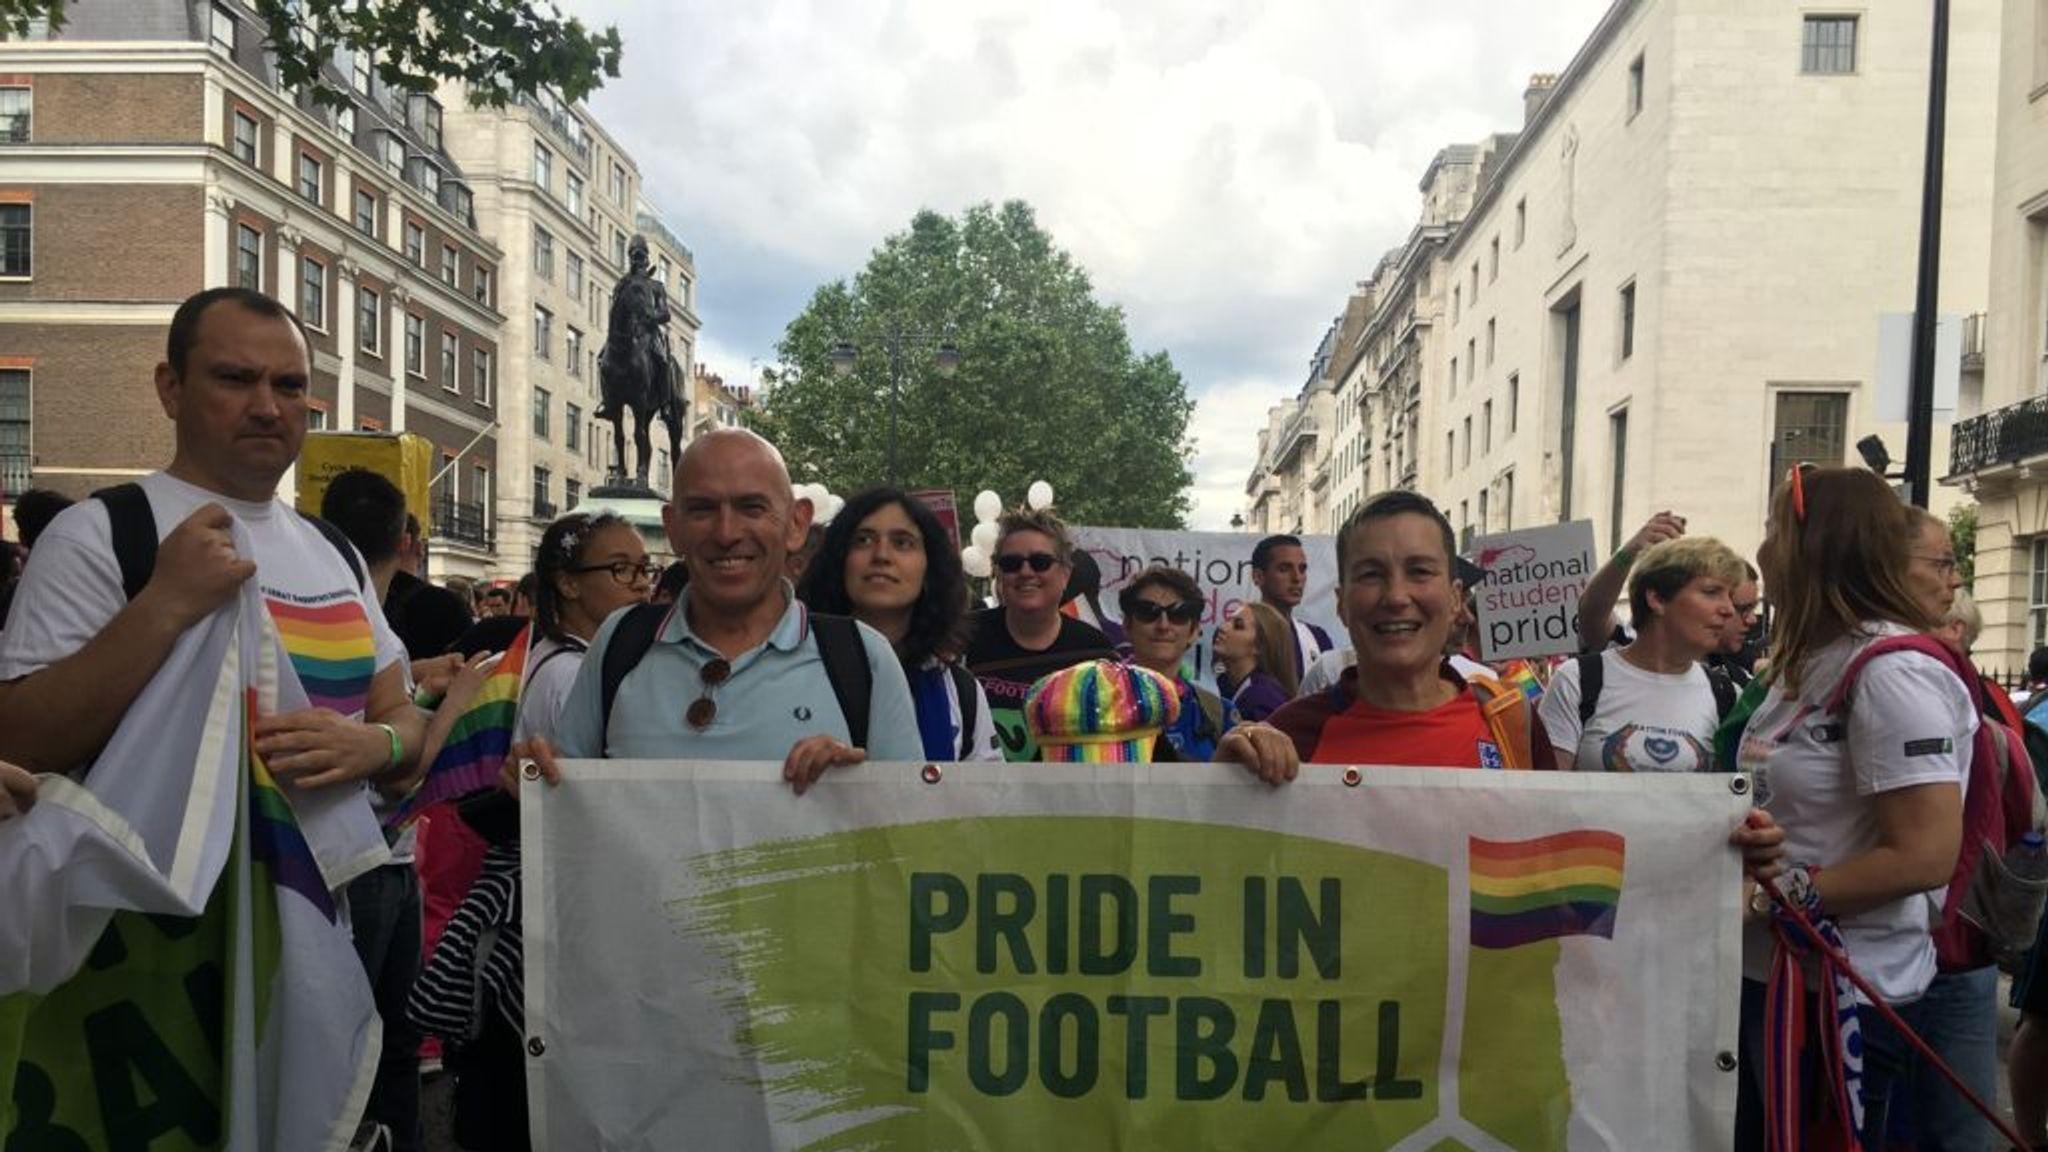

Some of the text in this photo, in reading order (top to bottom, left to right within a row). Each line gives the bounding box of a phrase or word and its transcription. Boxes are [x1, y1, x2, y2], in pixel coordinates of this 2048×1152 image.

[1483, 550, 1590, 588] national
[909, 872, 1342, 981] PRIDE IN
[906, 991, 1423, 1102] FOOTBALL
